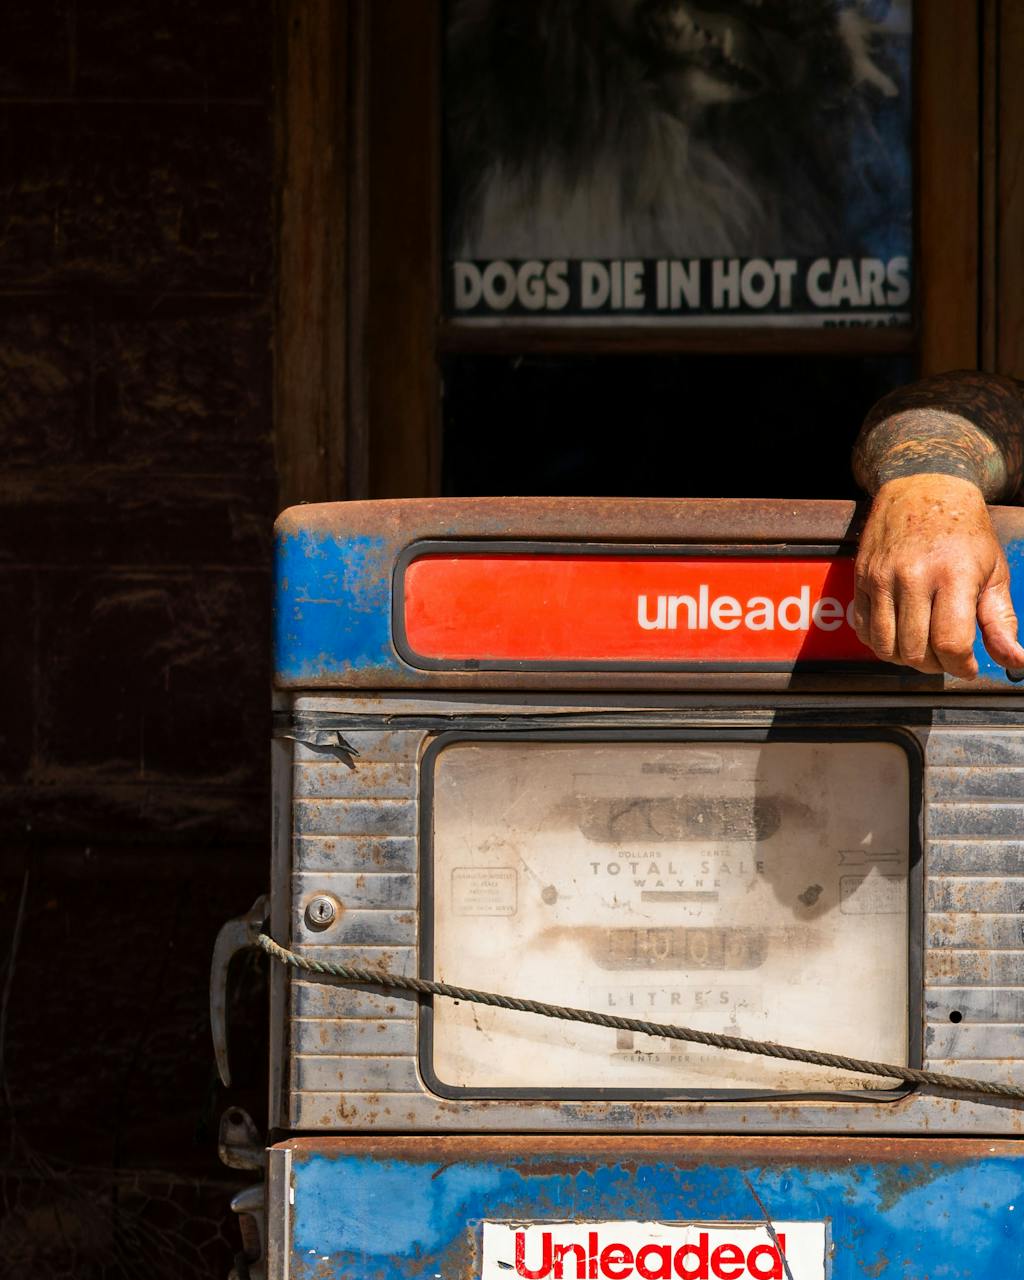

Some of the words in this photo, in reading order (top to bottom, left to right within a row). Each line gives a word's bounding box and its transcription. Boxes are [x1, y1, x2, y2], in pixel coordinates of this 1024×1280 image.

[453, 261, 570, 310] DOGS
[581, 260, 646, 309] DIE
[656, 260, 700, 309] IN
[712, 258, 797, 308] HOT
[805, 256, 911, 307] CARS
[637, 584, 857, 631] unleade
[589, 862, 678, 876] TOTAL
[700, 861, 766, 875] SALE
[633, 879, 721, 888] WAYNE
[608, 991, 730, 1007] LITRES
[515, 1231, 787, 1280] Unleaded
